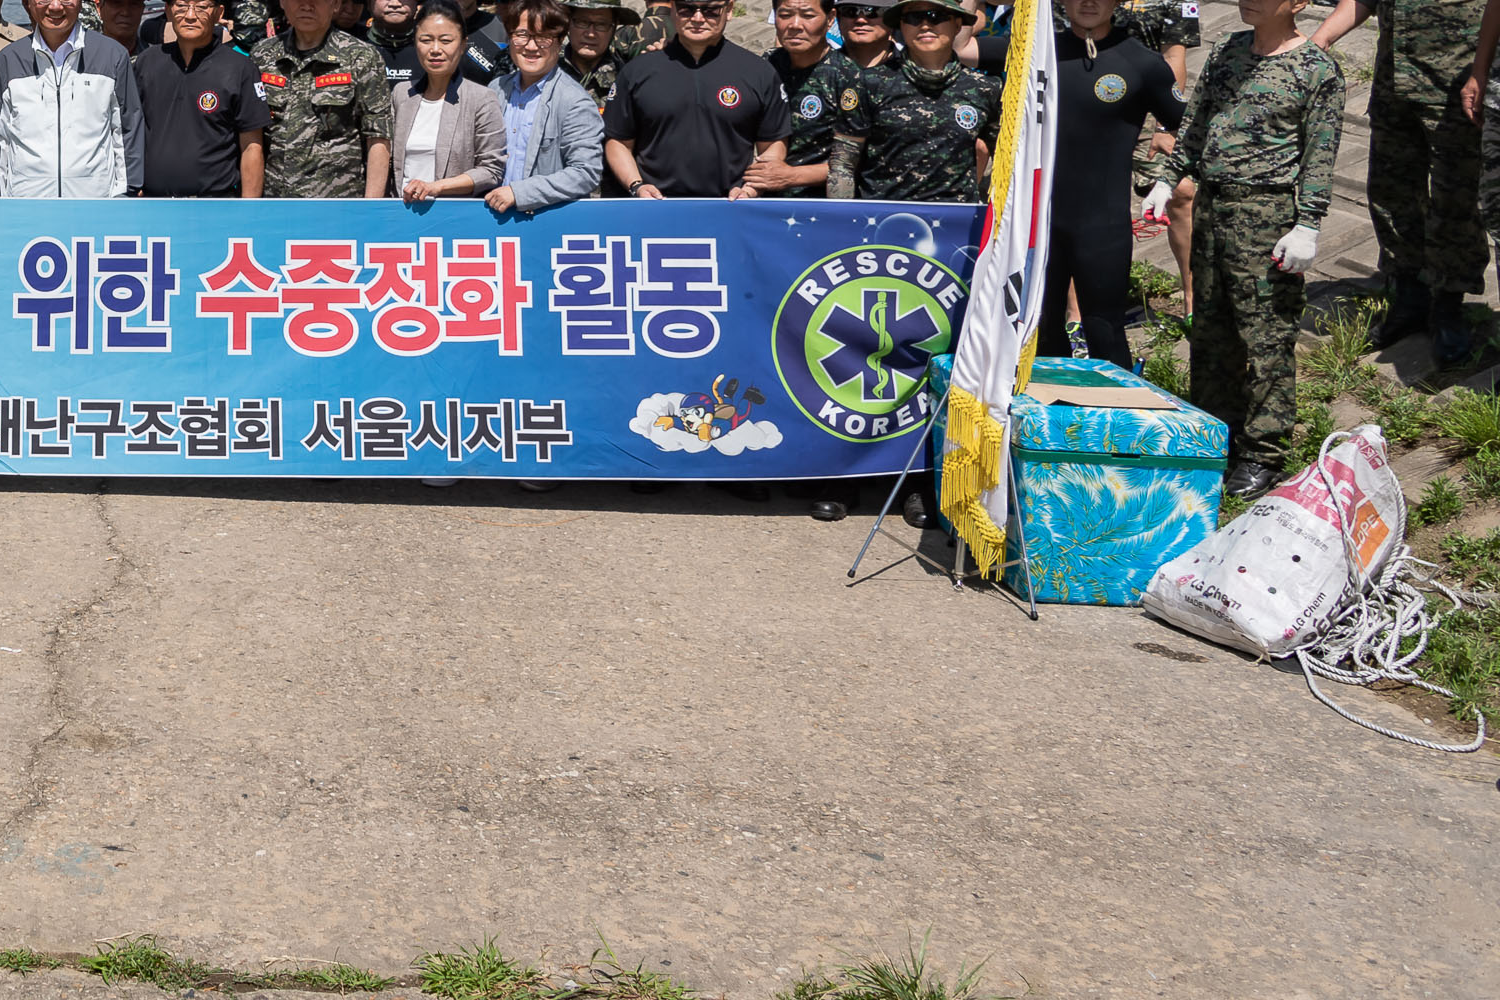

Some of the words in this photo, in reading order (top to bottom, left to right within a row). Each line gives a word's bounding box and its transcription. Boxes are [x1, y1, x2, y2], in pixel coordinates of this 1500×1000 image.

[467, 46, 493, 72] seac
[13, 236, 180, 354] 위한
[196, 237, 532, 357] 수중정화
[549, 235, 727, 359] 활동
[796, 251, 964, 310] RESCUE
[302, 397, 573, 462] 서울시지부
[1293, 616, 1306, 632] LG
[1303, 591, 1327, 618] Chem
